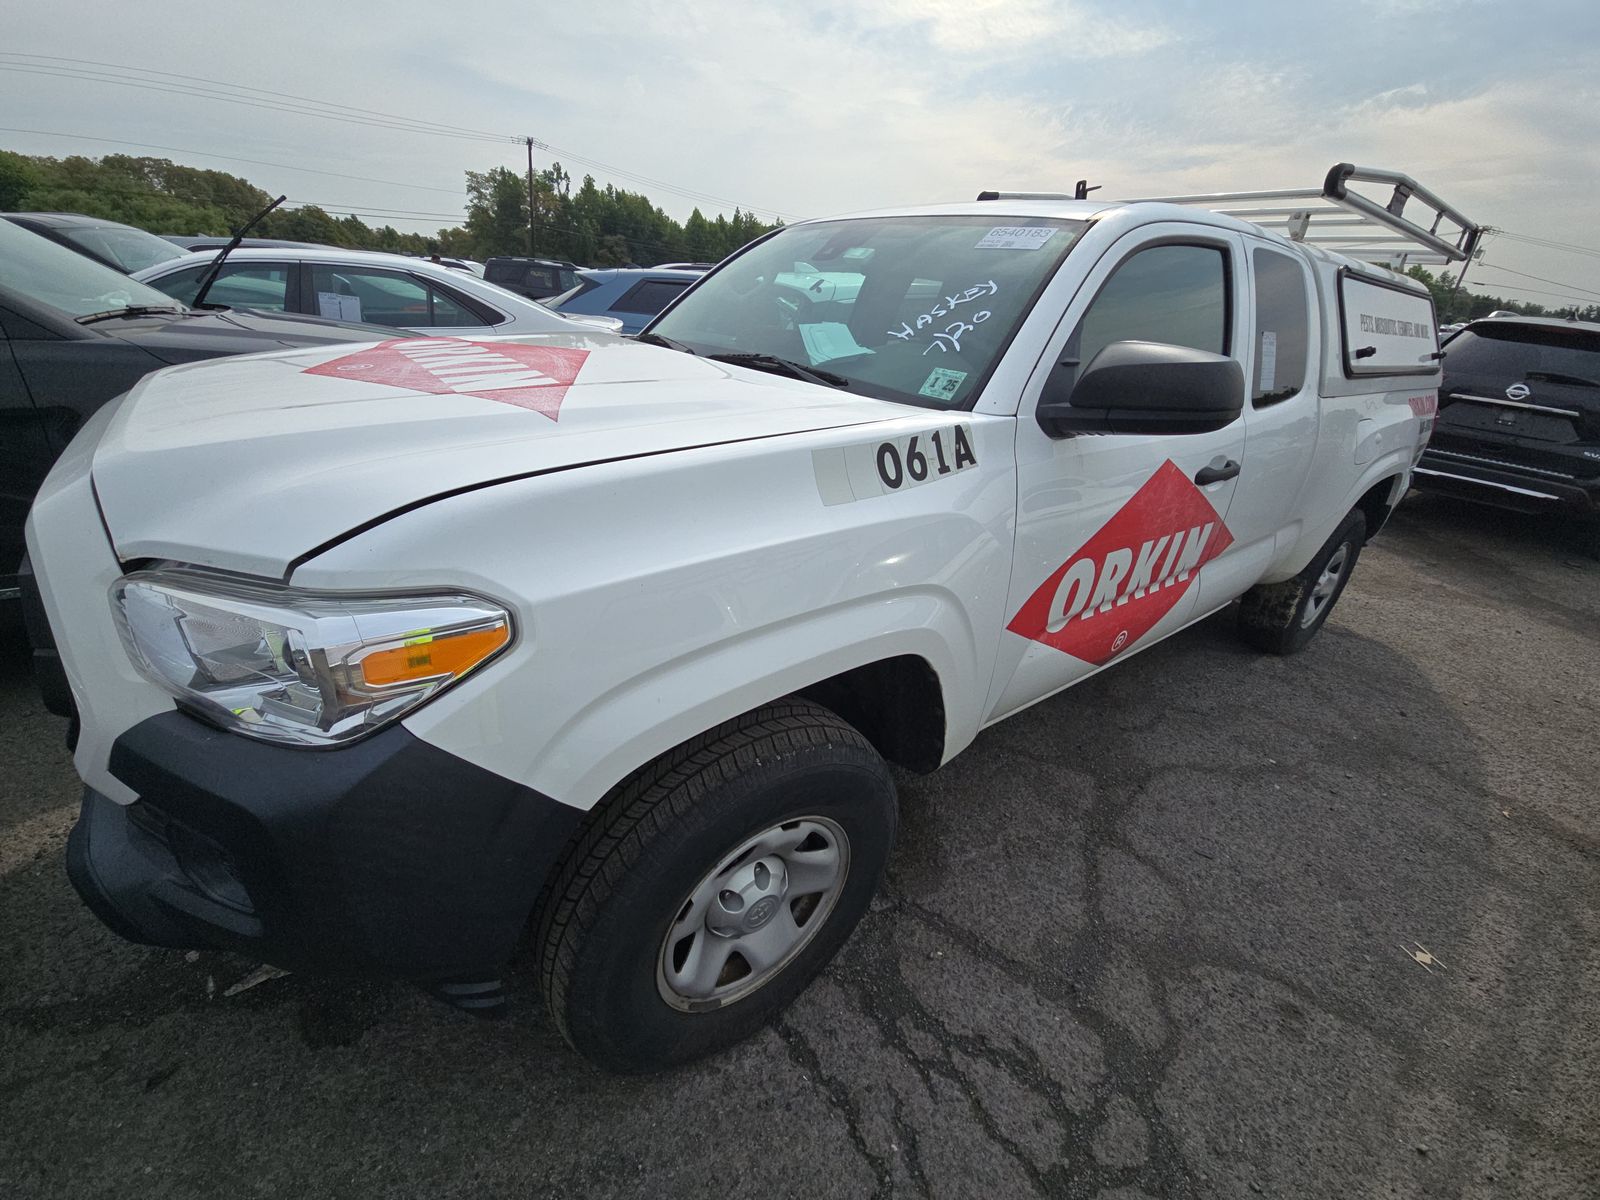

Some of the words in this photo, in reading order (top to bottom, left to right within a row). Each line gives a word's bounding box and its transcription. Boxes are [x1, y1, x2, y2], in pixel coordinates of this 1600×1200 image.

[990, 228, 1051, 238] 6540183
[390, 339, 561, 393] ORKIN
[942, 379, 960, 391] 25
[876, 424, 978, 489] 061A
[1046, 521, 1214, 634] ORKIN
